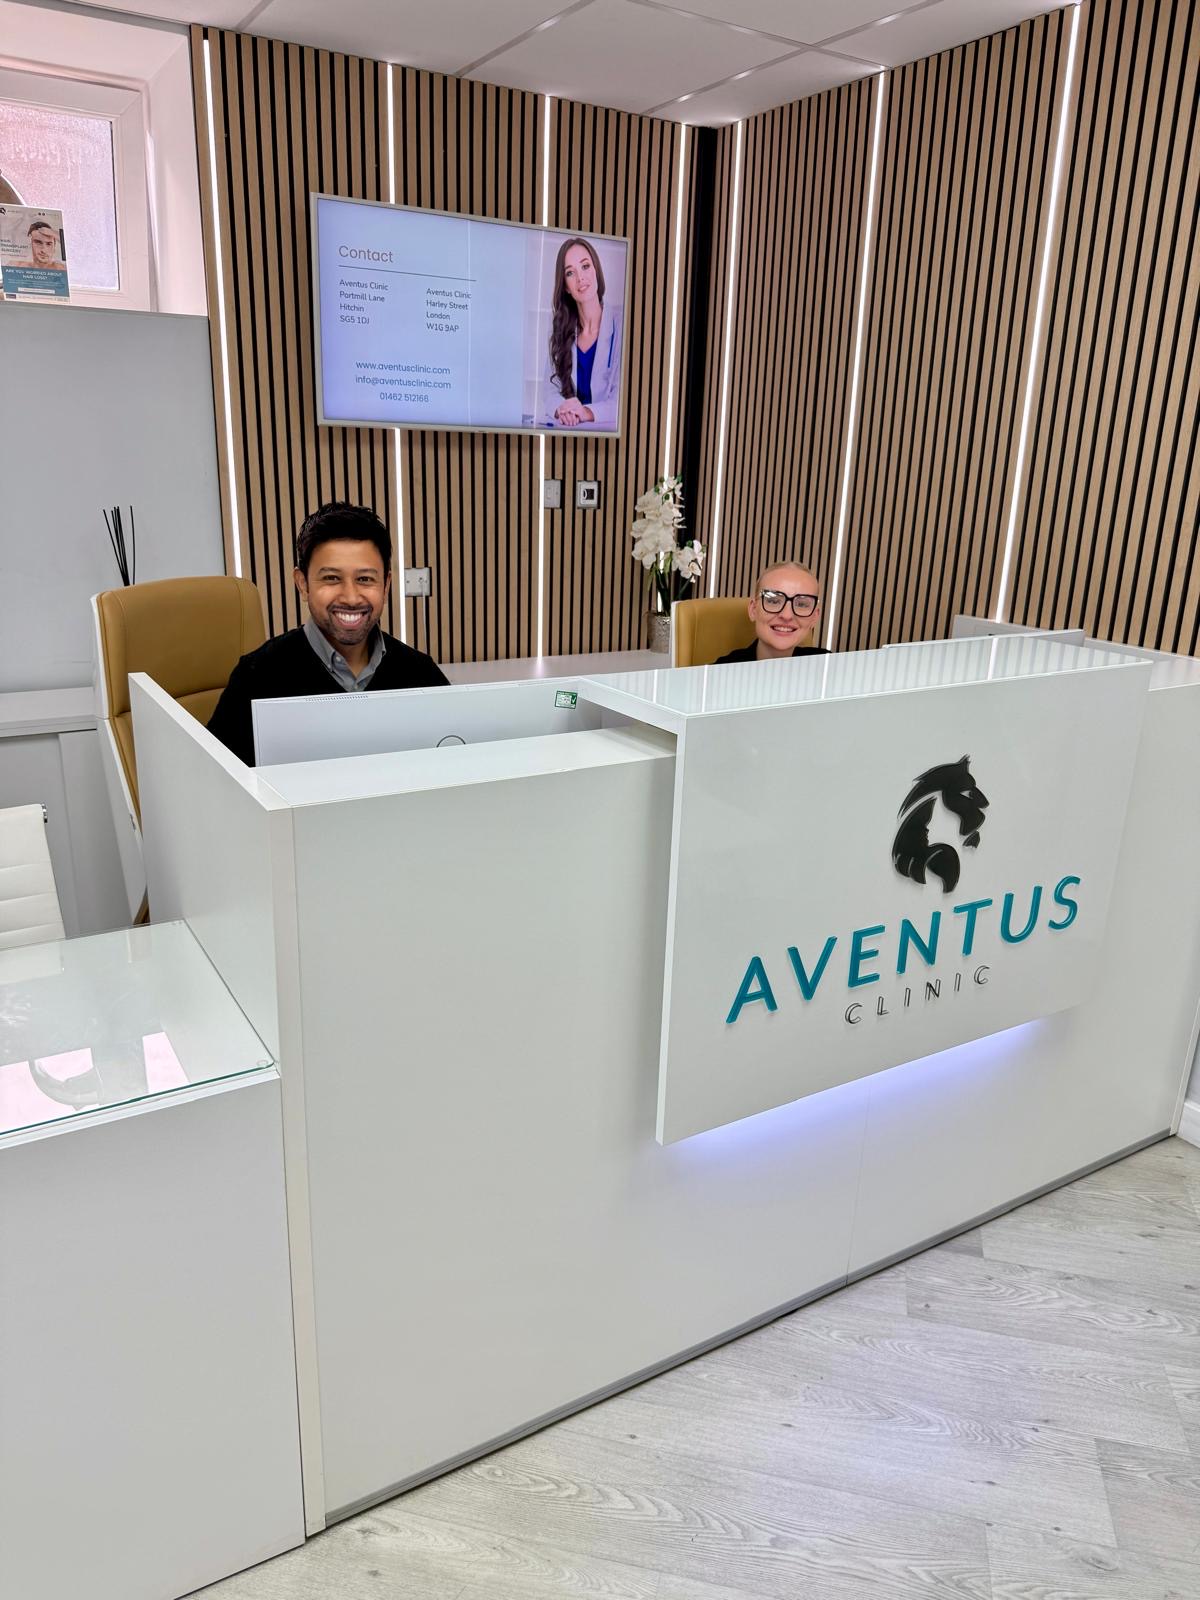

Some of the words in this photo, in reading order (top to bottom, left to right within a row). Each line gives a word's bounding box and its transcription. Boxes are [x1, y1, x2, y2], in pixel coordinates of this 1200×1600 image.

[338, 245, 394, 262] Contact
[339, 279, 368, 289] Aventus
[369, 281, 389, 291] Clinic
[339, 291, 367, 301] Portmill
[368, 294, 385, 302] Lane
[426, 288, 453, 298] Aventus
[454, 290, 472, 299] Clinic
[339, 303, 365, 312] Hitchin
[426, 299, 448, 309] Harley
[449, 301, 469, 310] Street
[339, 315, 356, 324] SG5
[357, 316, 370, 325] 1DJ
[426, 311, 451, 320] London
[426, 322, 444, 332] W1G
[444, 324, 460, 333] 9AP
[355, 361, 451, 374] www.aventusclinic.com
[355, 375, 452, 389] info@aventusclinic.com
[379, 391, 403, 402] 01462
[725, 875, 1081, 1025] AVENTUS
[844, 965, 991, 1025] CLINIC
